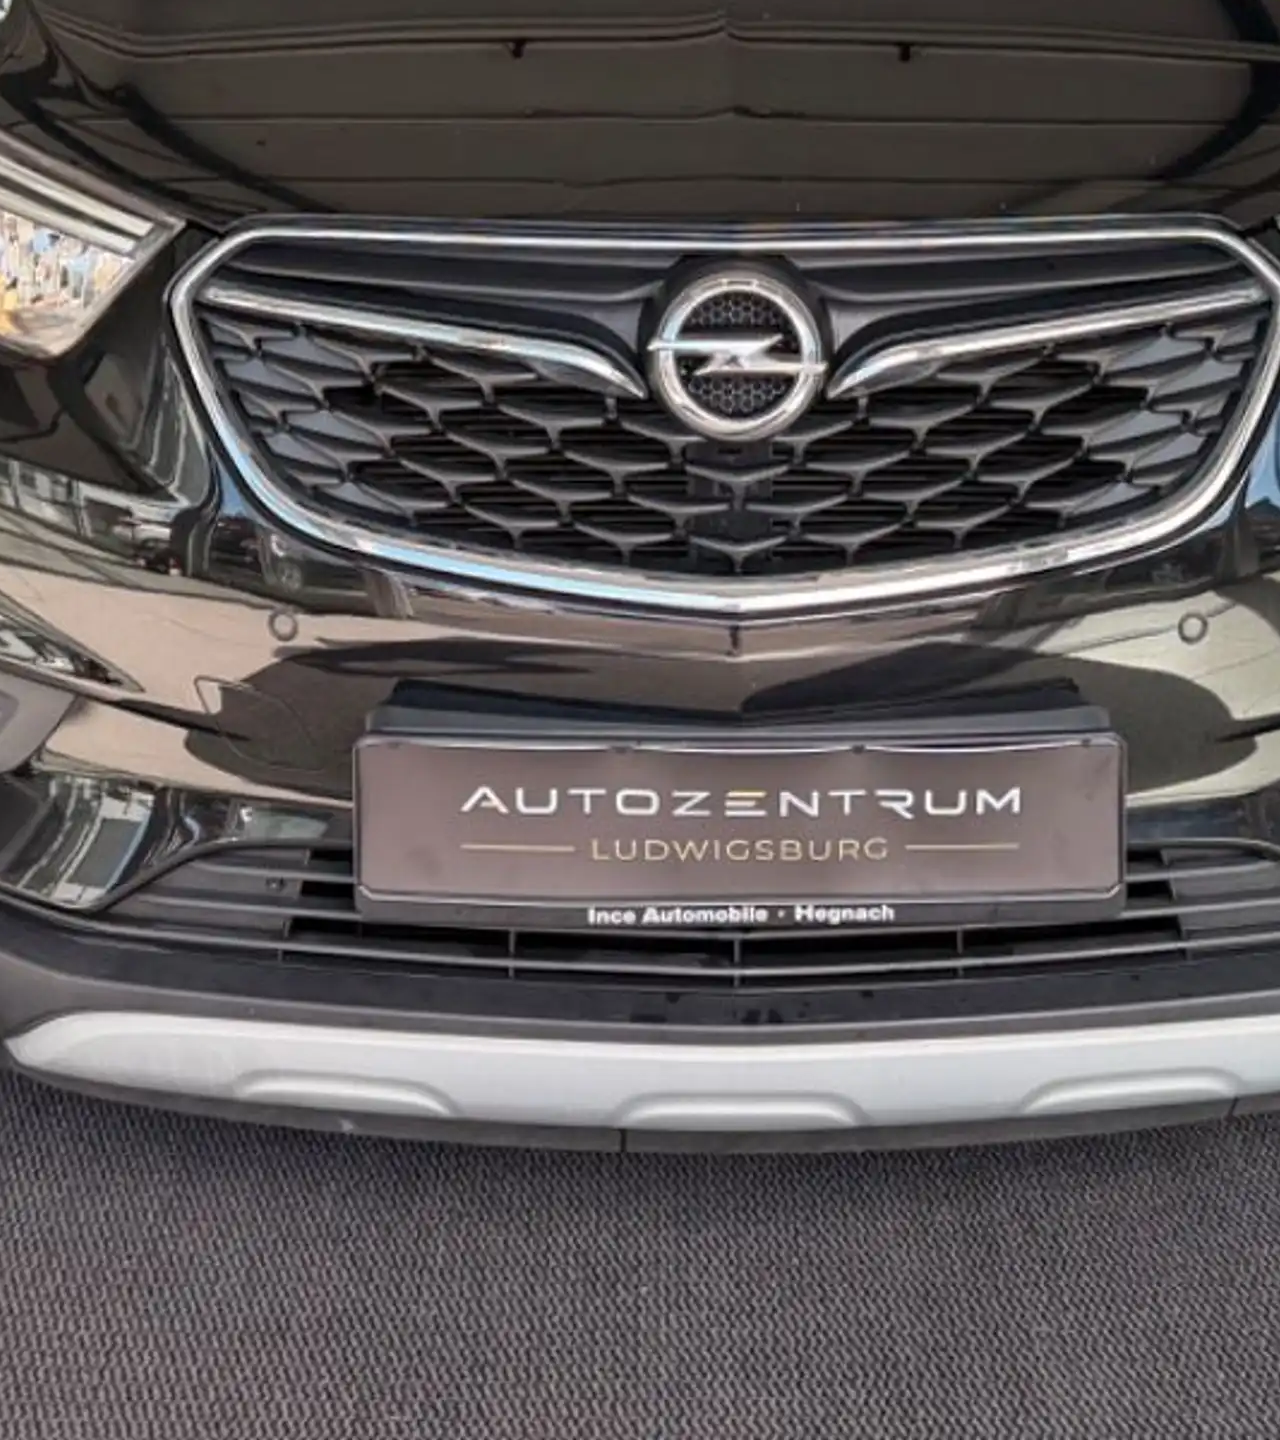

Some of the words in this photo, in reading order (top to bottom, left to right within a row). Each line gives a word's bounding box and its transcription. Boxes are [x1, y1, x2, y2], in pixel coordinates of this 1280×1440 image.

[460, 786, 1022, 818] AUTOZENTRUM
[591, 836, 889, 862] LUDWIGSBURG
[587, 906, 637, 926] Ince
[641, 906, 769, 926] Automobile
